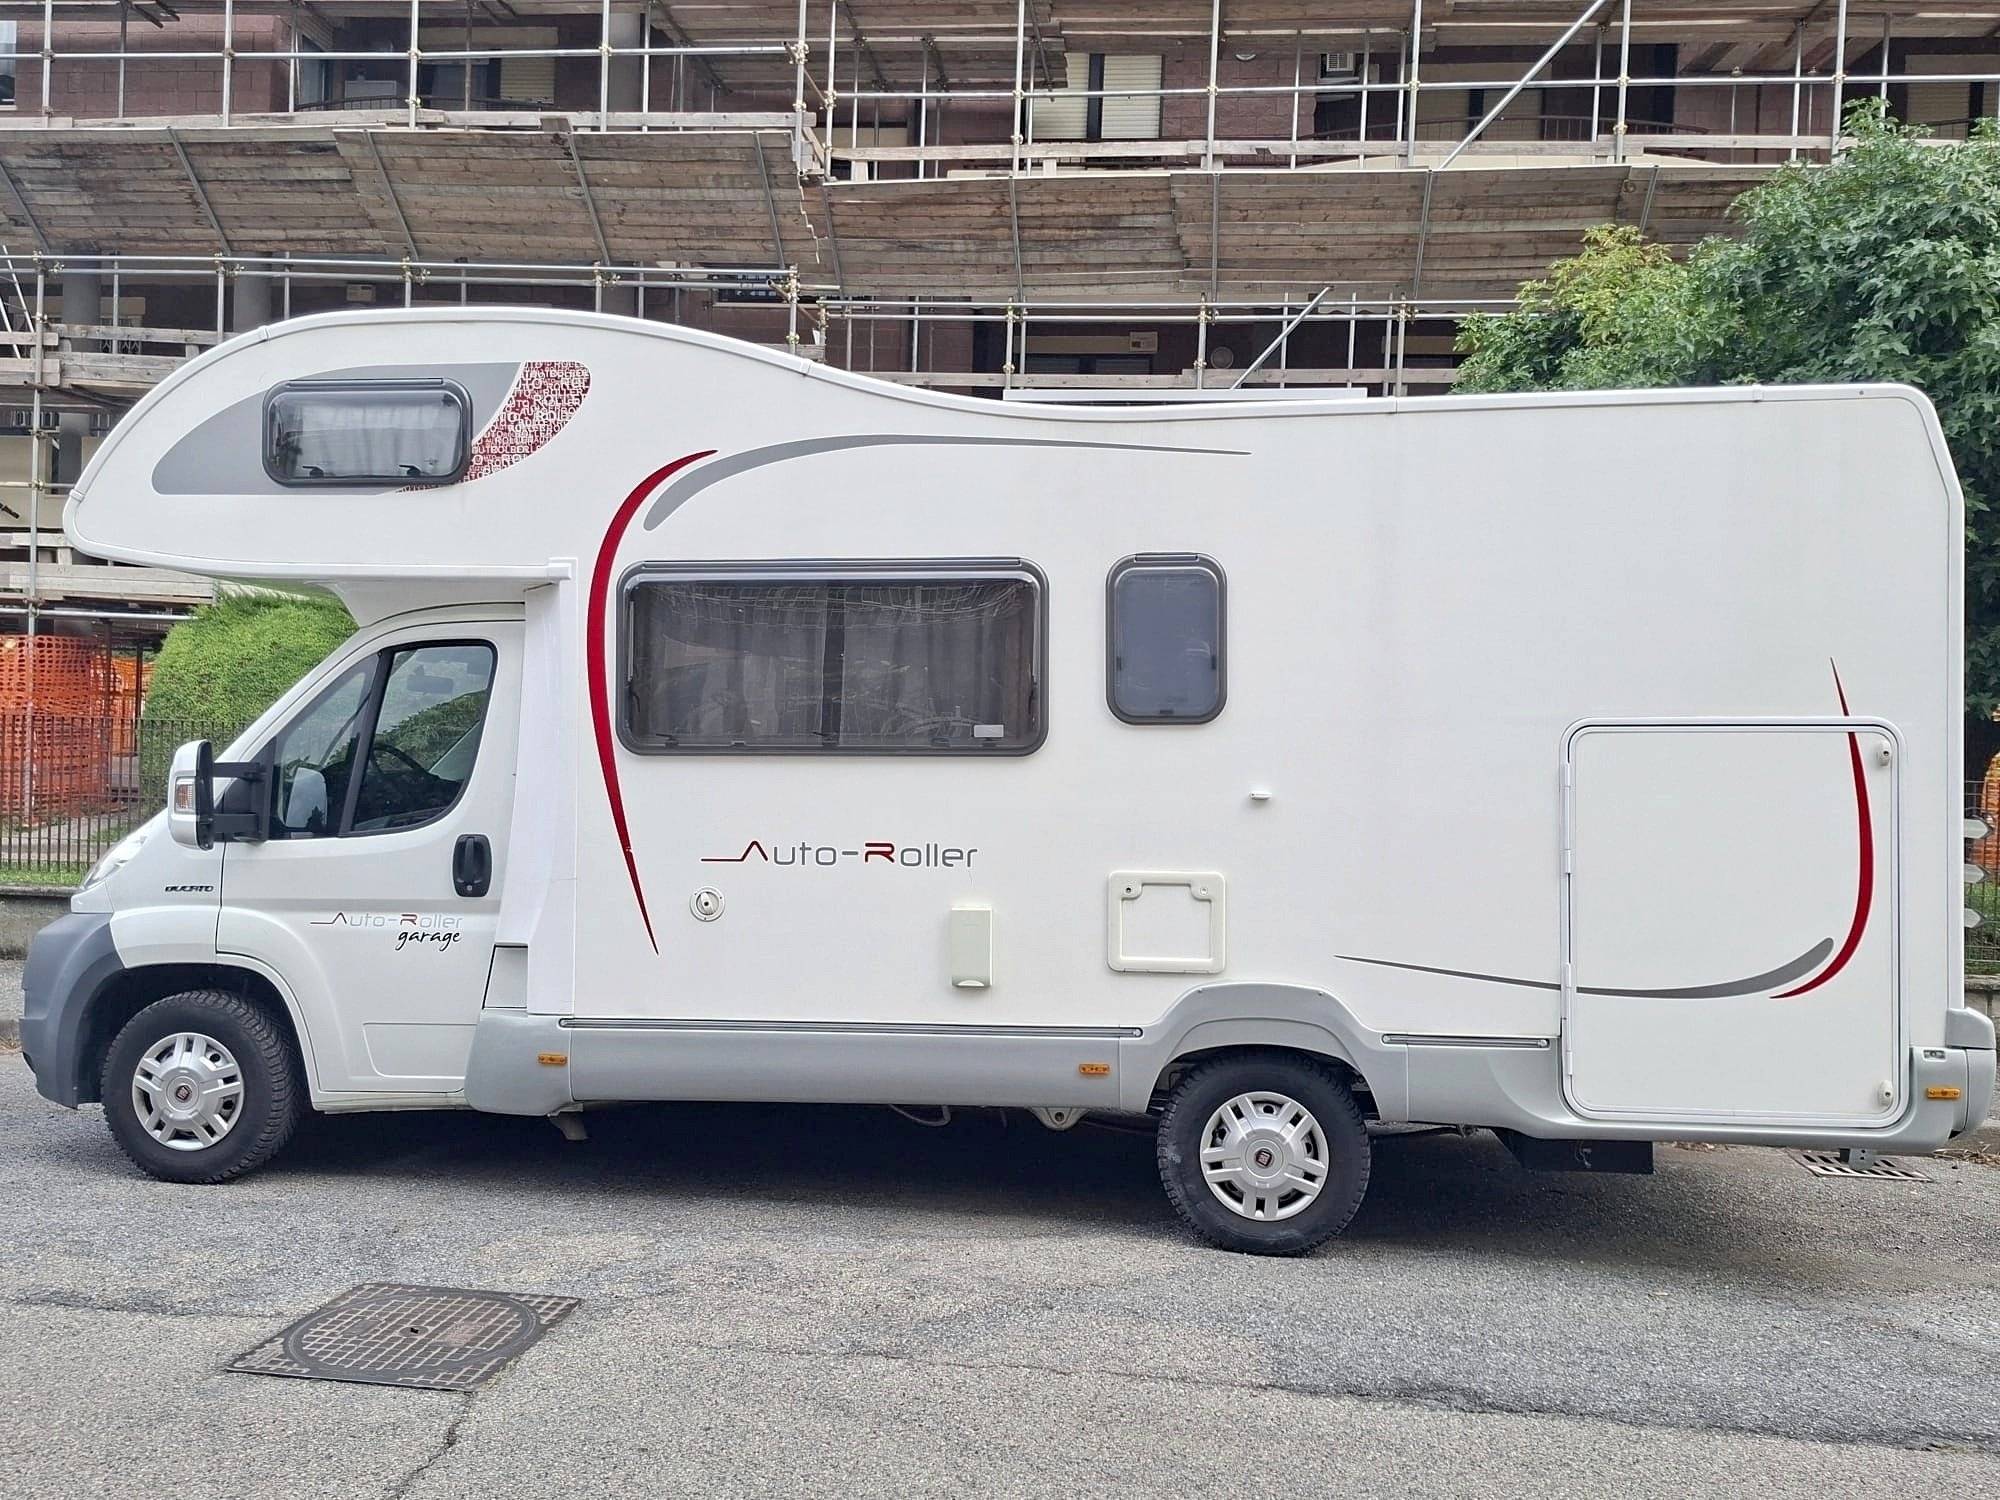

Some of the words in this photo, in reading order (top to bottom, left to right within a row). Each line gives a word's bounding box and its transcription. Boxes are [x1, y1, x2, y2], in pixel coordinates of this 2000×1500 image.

[700, 840, 978, 867] Auto-Roller
[165, 884, 214, 893] DUCATO
[310, 911, 462, 929] Auto-Roller
[395, 929, 461, 951] garage
